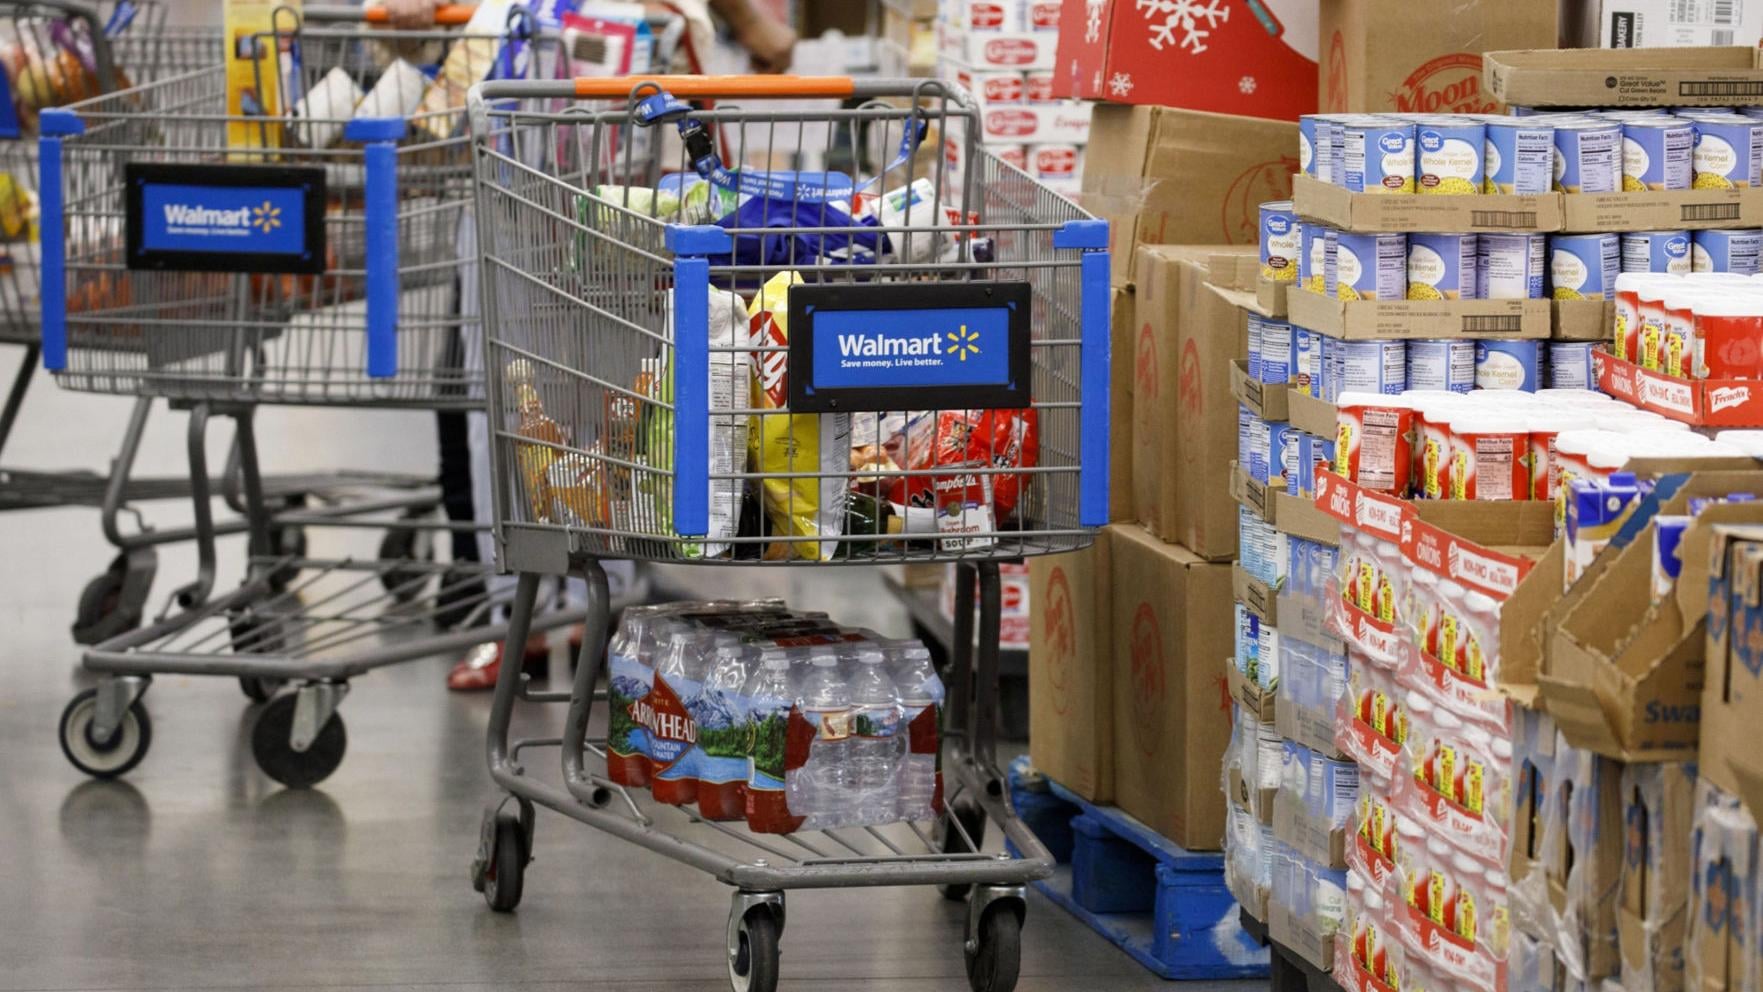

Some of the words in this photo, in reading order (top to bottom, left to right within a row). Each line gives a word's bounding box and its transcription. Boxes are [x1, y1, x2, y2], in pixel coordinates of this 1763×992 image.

[1396, 75, 1479, 113] Moon
[164, 204, 250, 226] Walmart
[1270, 241, 1294, 249] Whole
[838, 333, 942, 356] Walmart
[863, 360, 893, 368] money.
[914, 358, 943, 366] better.
[1713, 389, 1746, 406] French's
